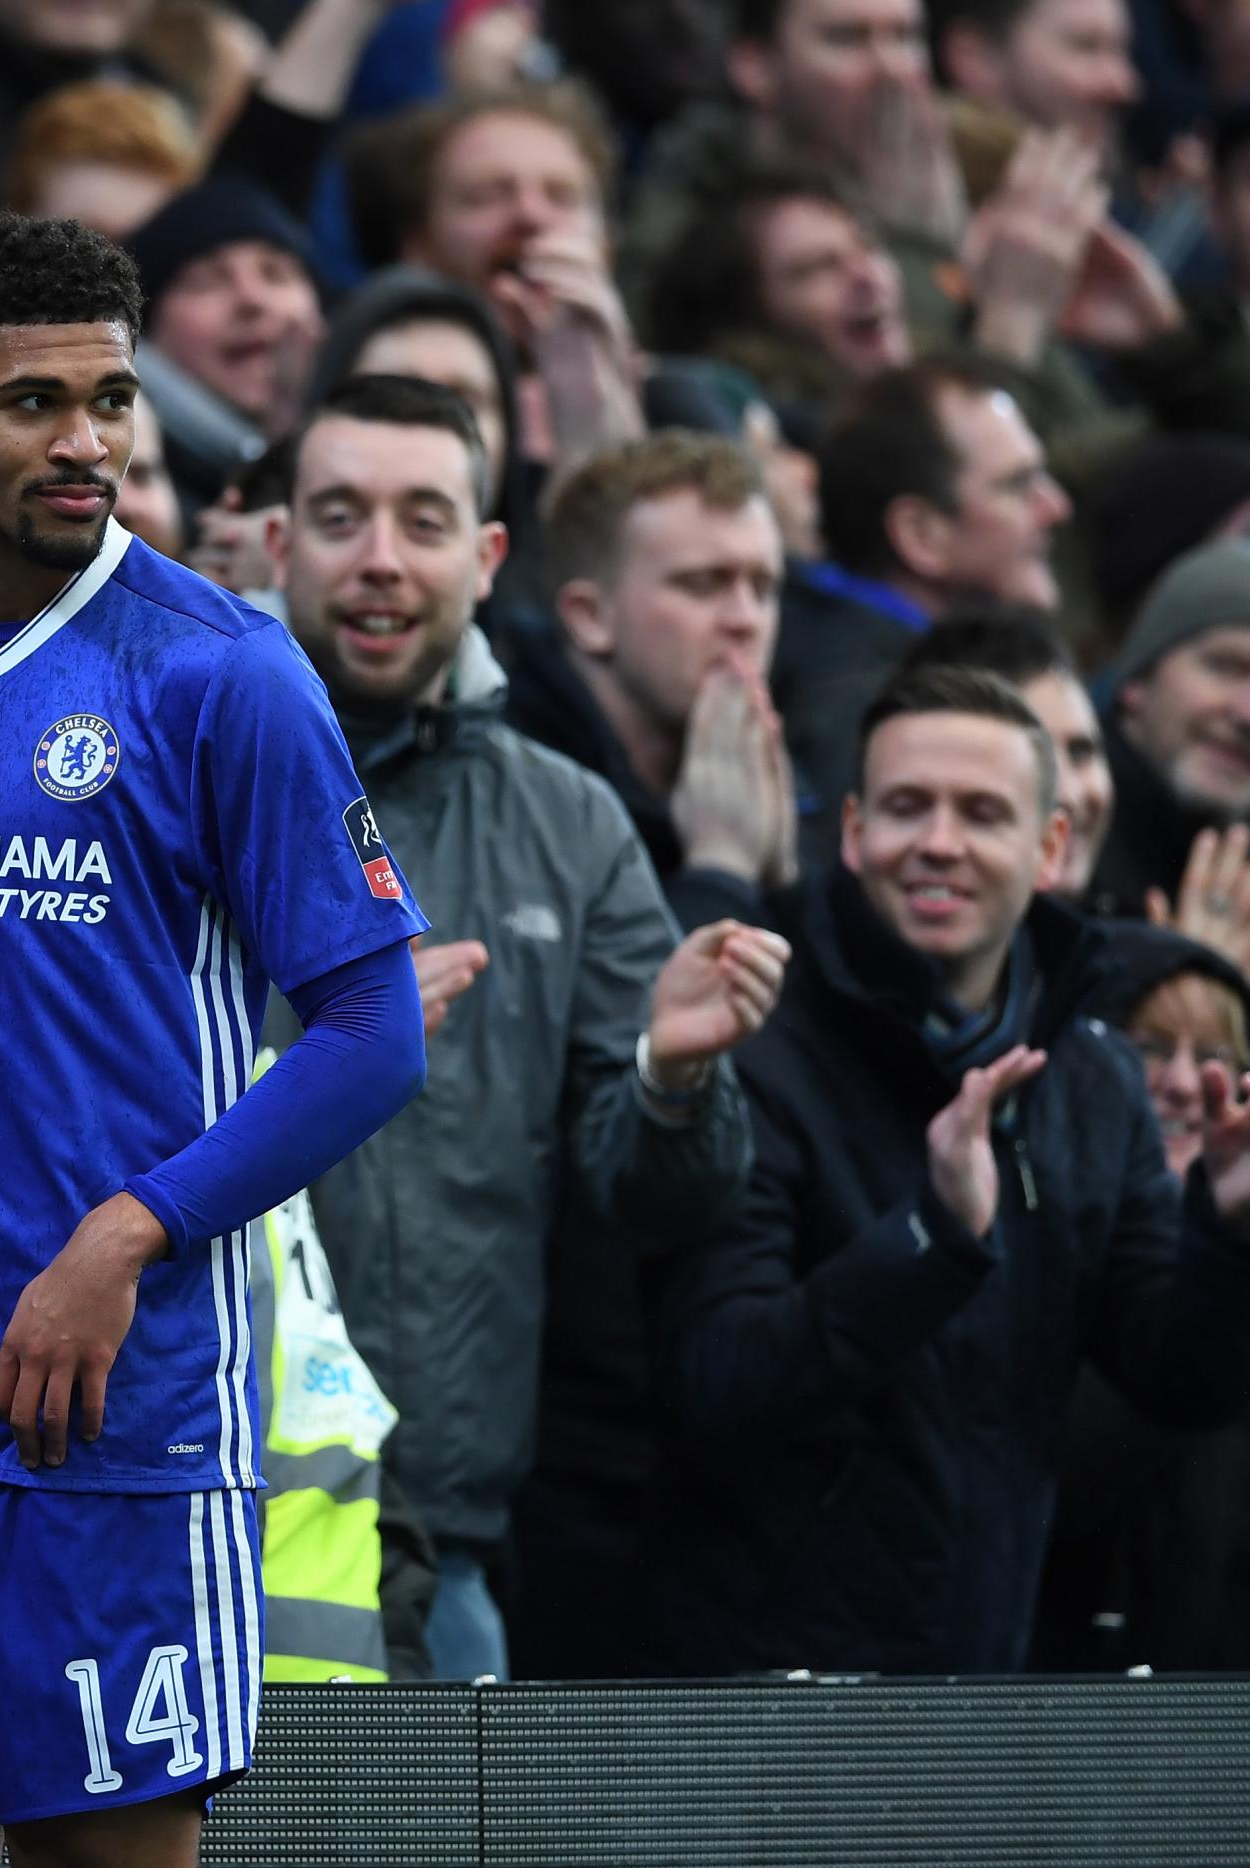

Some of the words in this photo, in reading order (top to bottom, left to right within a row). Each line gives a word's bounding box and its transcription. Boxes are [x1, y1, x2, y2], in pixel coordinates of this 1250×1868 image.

[55, 717, 109, 738] CHELSEA
[43, 777, 77, 796] FOOTBALL
[79, 781, 99, 795] CLUB
[167, 1443, 204, 1454] adizero
[65, 1644, 203, 1794] 14
